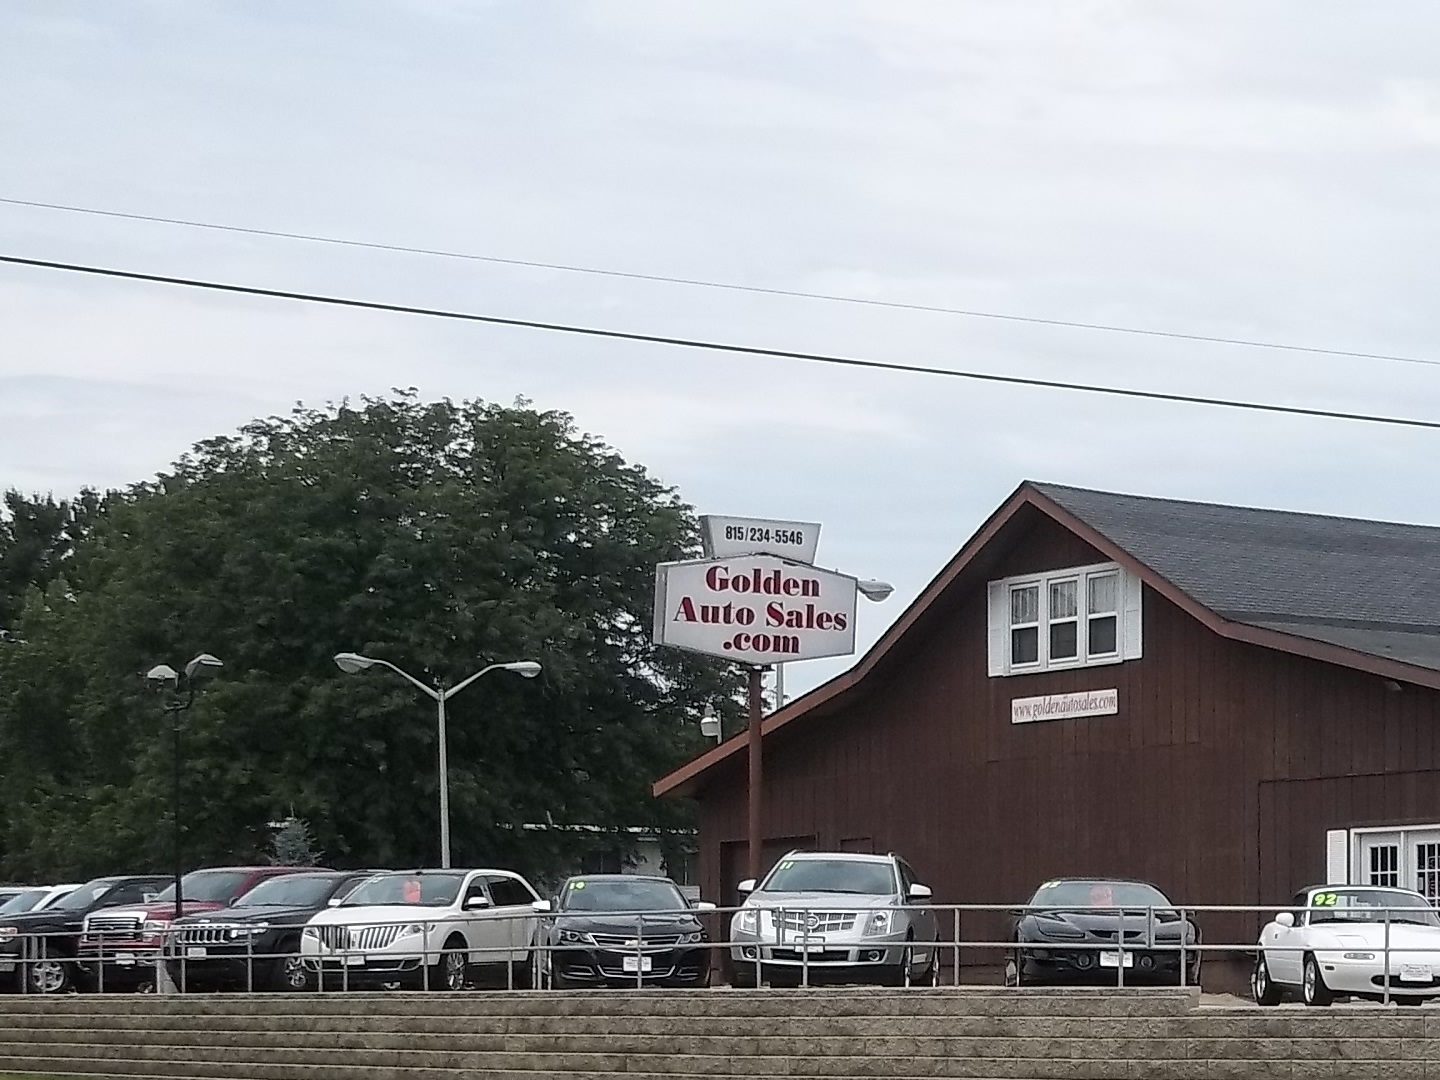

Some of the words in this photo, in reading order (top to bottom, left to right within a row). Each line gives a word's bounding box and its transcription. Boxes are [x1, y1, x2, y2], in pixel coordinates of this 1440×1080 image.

[725, 525, 804, 546] 815/234-5546
[705, 565, 821, 598] Golden
[673, 596, 755, 626] Auto
[765, 601, 848, 632] Sales
[723, 632, 800, 654] .com
[1013, 691, 1116, 719] www.goldenautosales.com
[1314, 893, 1337, 906] 92
